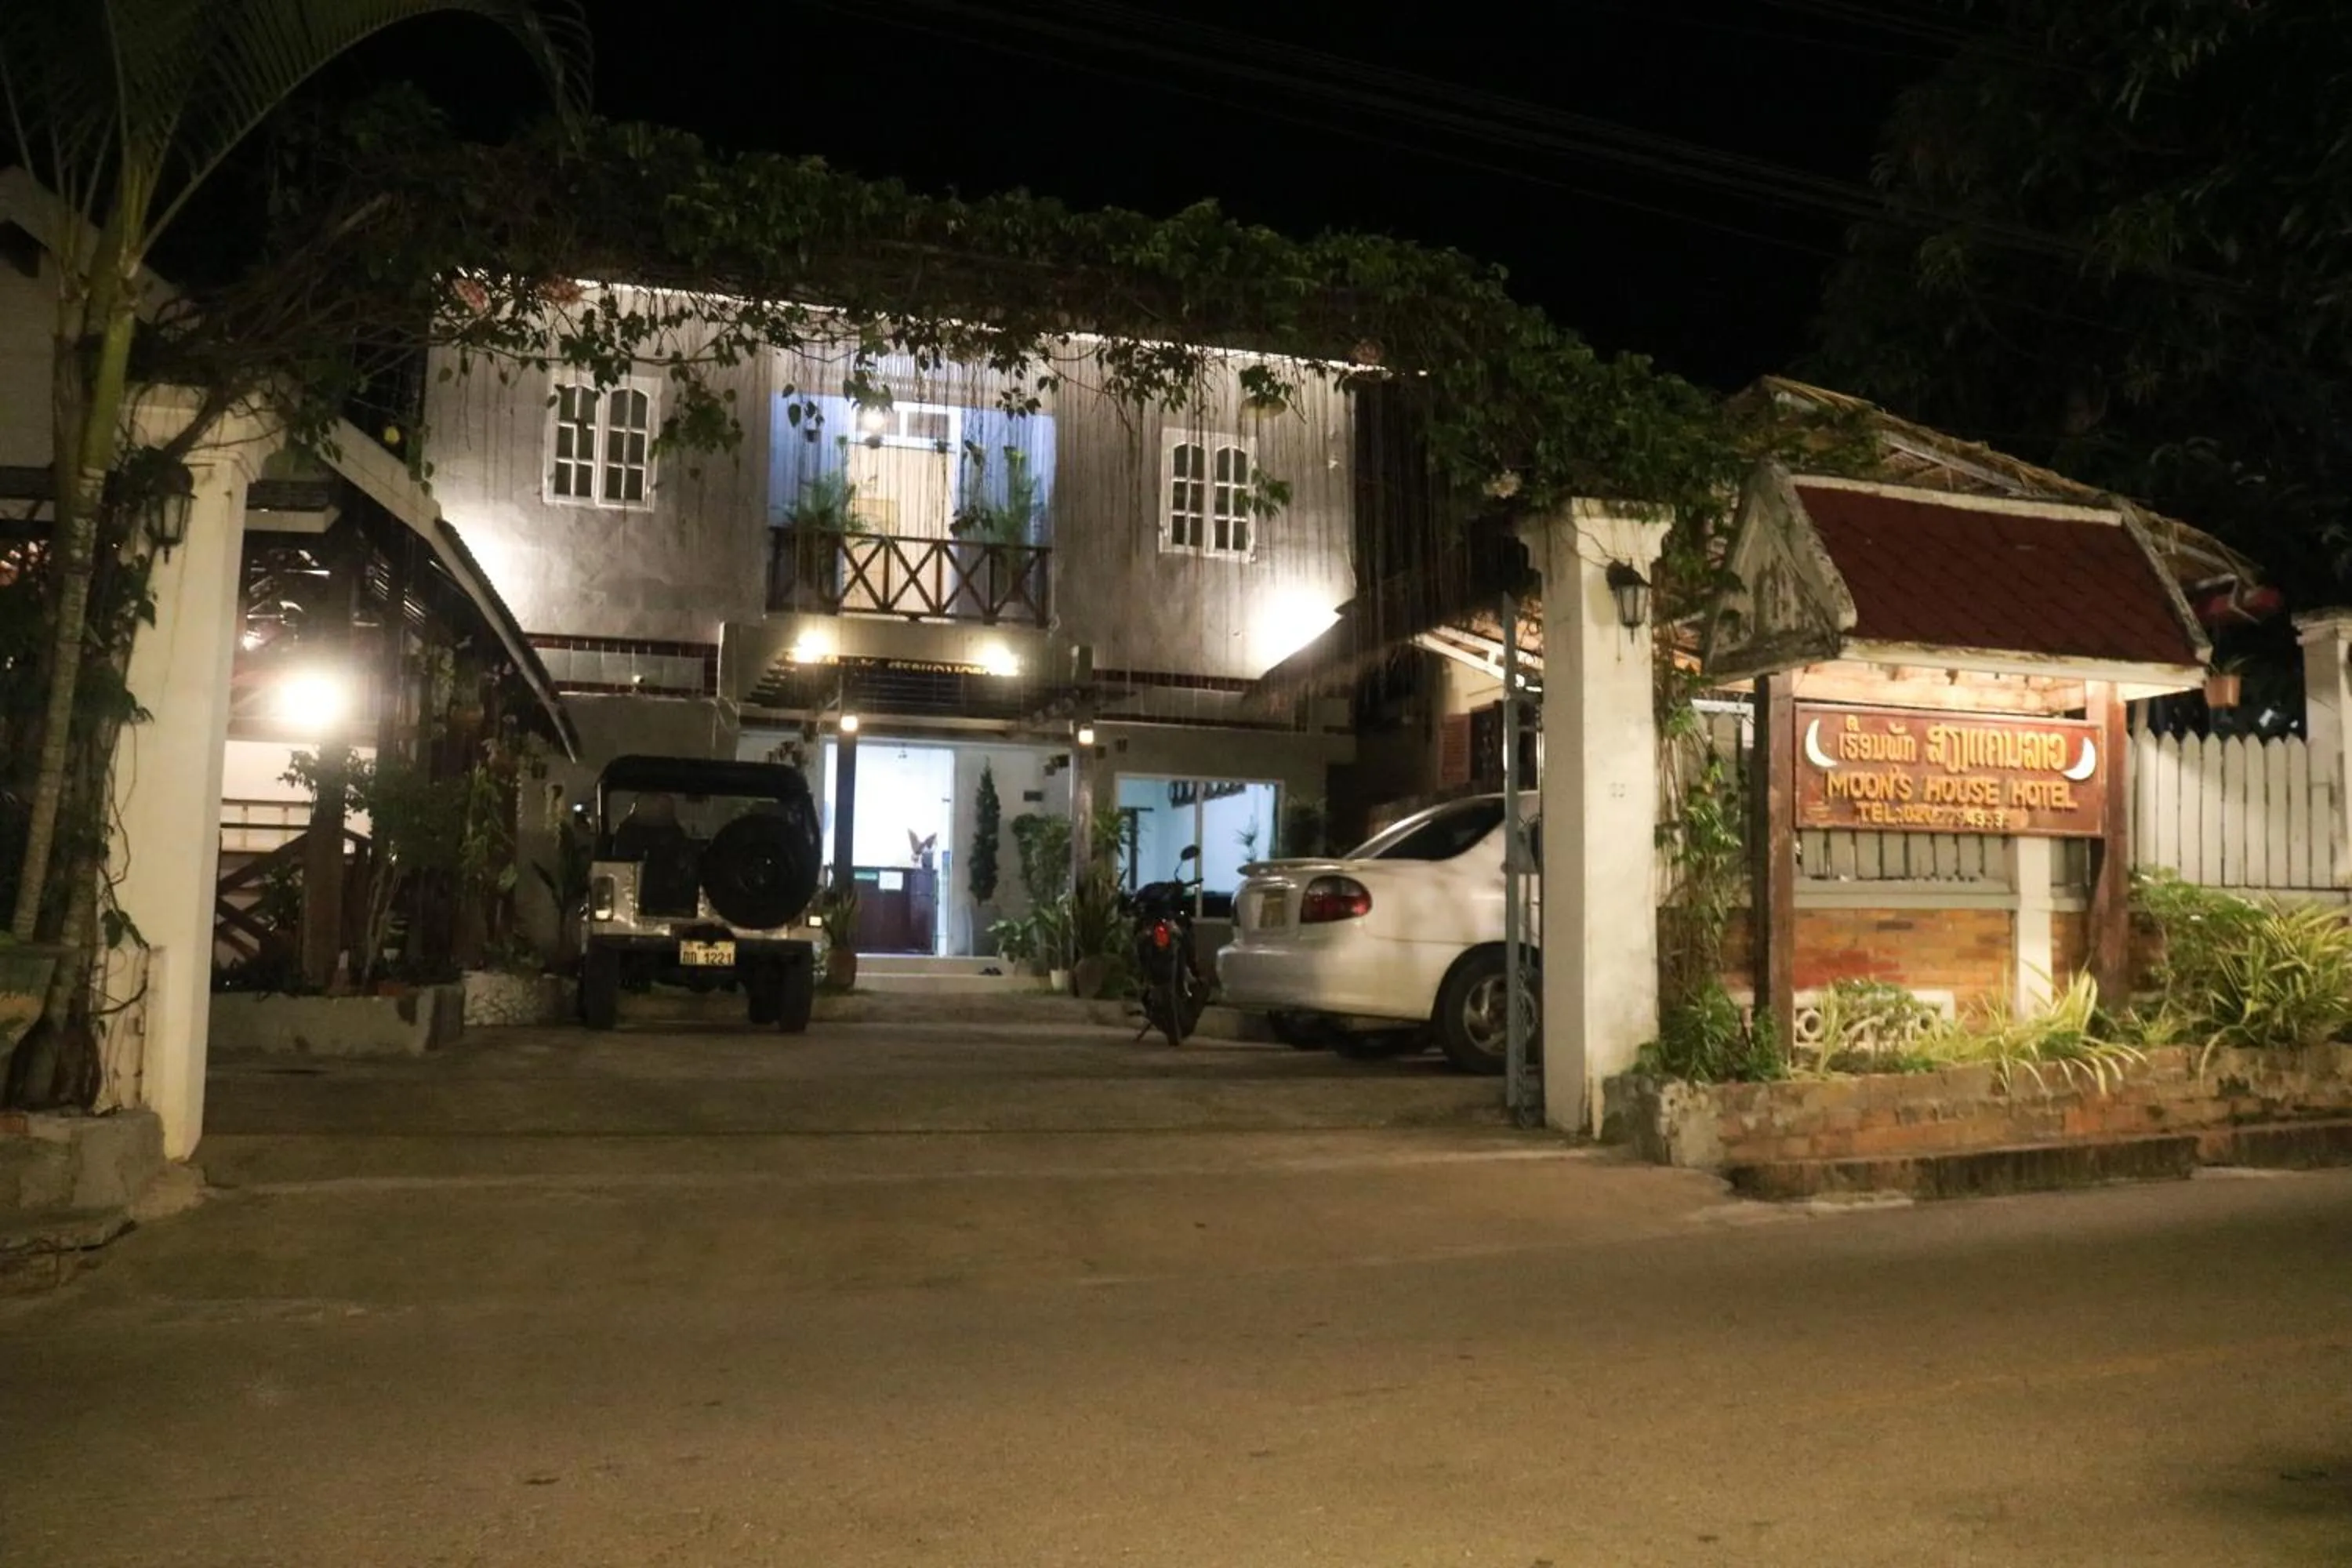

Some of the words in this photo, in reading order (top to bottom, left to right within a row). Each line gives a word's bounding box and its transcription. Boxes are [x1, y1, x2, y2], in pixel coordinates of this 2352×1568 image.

[1826, 766, 1913, 801] MOON'S
[1924, 775, 2000, 807] HOUSE
[2011, 779, 2078, 810] HOTEL
